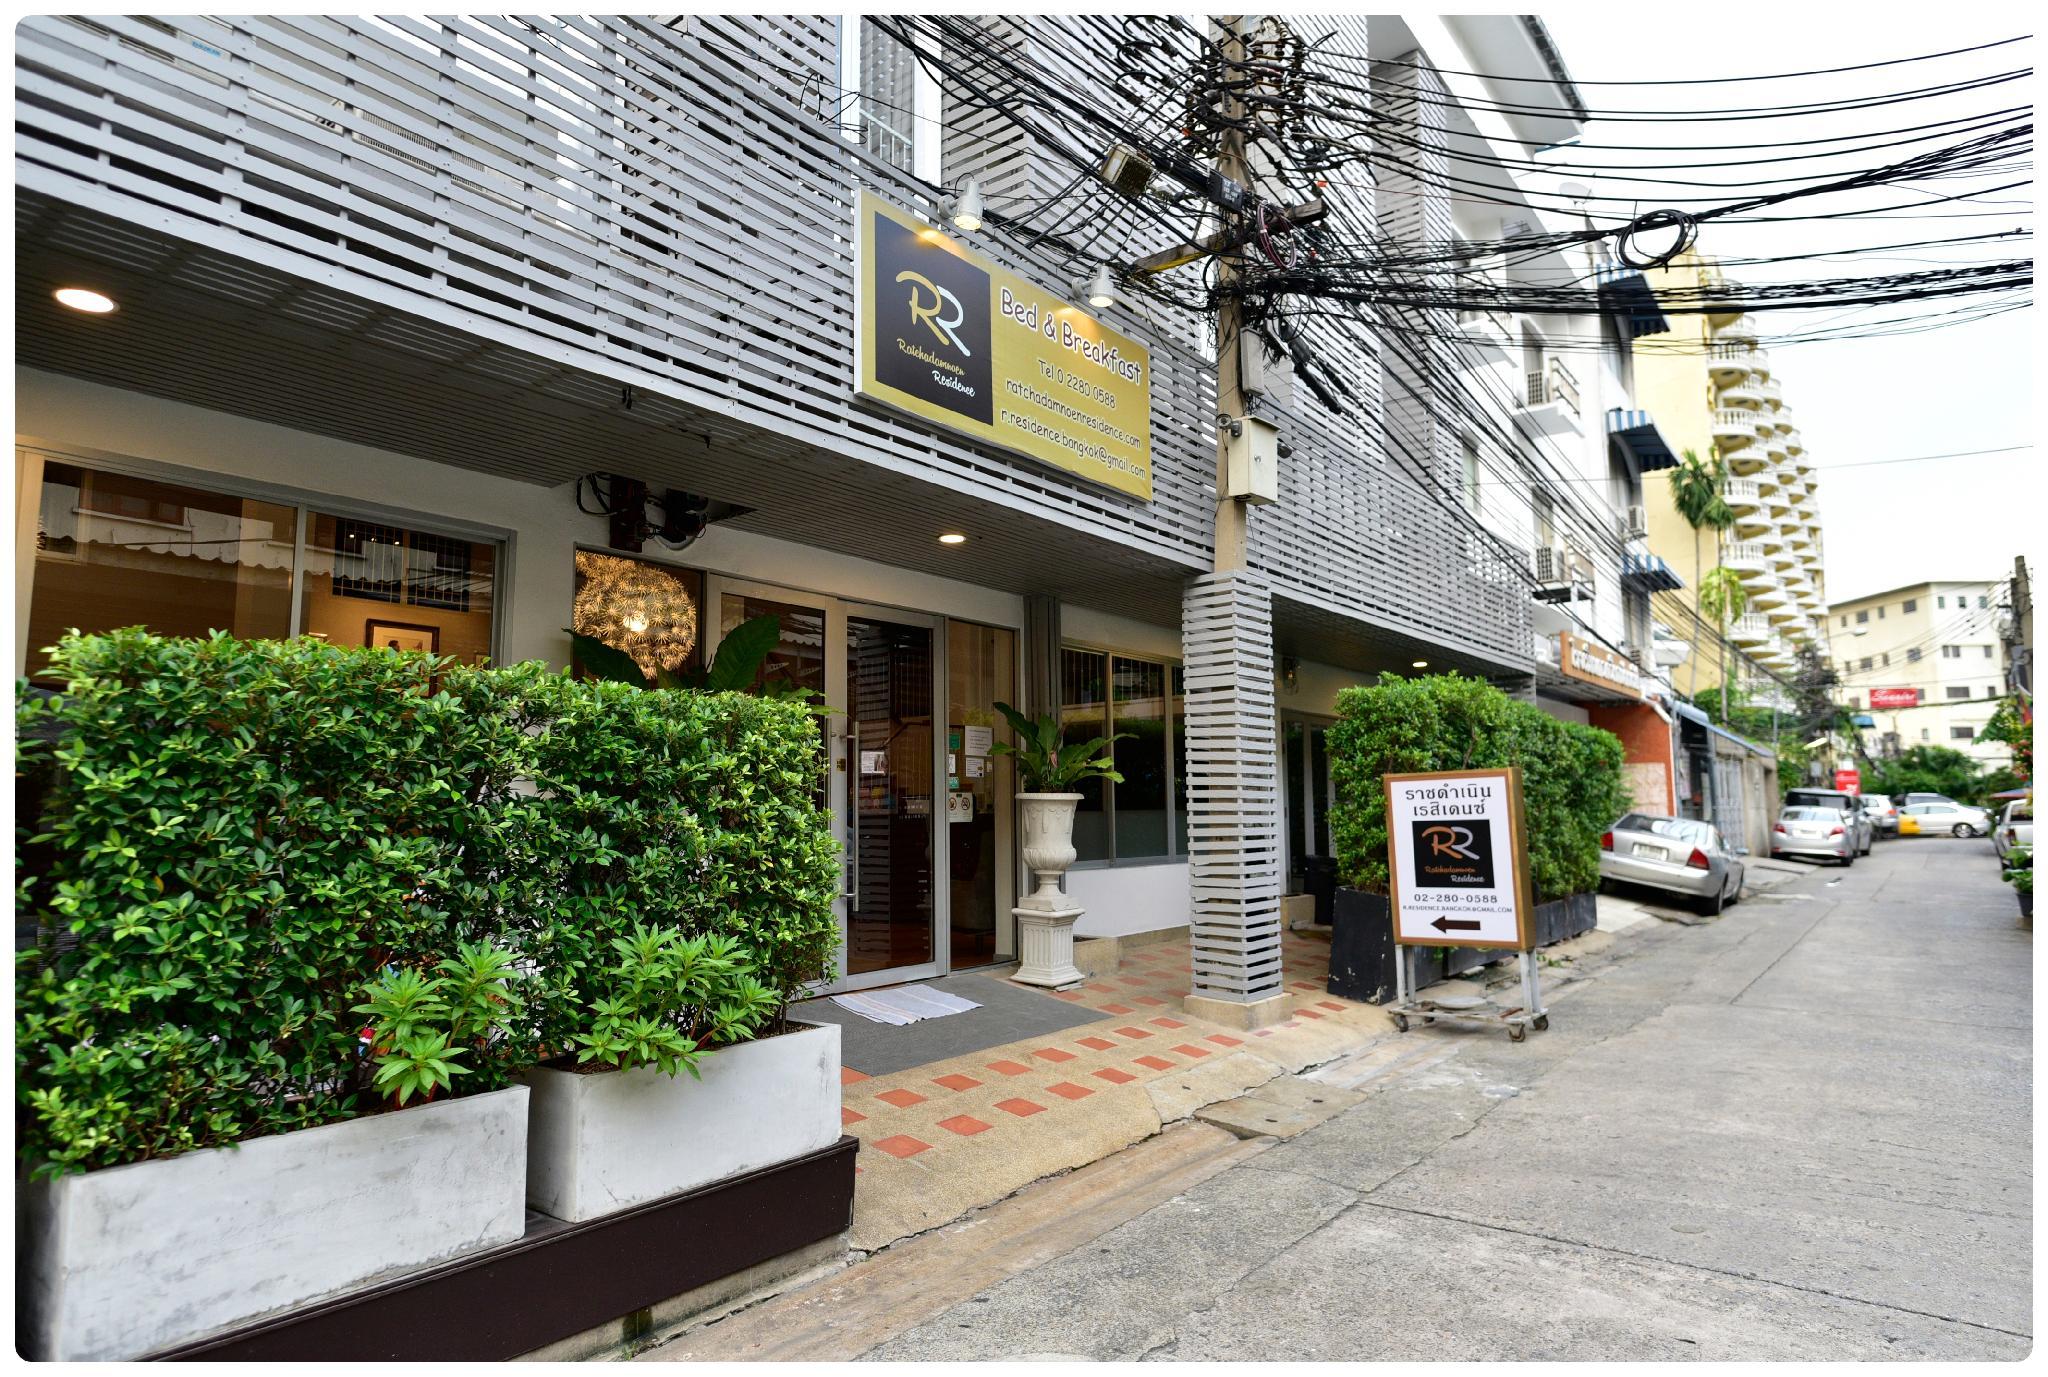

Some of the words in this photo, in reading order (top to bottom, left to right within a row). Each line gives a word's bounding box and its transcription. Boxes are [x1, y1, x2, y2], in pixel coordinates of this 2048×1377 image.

[1001, 288, 1038, 330] Bed
[1043, 313, 1057, 341] &
[1062, 321, 1142, 385] Breakfast
[896, 338, 966, 376] Ratchadamnoen
[931, 369, 976, 398] Residence
[1038, 359, 1054, 380] Tel
[1057, 369, 1064, 384] 0
[1067, 373, 1091, 397] 2280
[1093, 386, 1116, 409] 0588
[1006, 380, 1141, 448] ratchadamnoenresidence.com
[1001, 409, 1146, 479] r.residence.bangkok@gmail.com
[1405, 783, 1491, 800] ราชดำเนิน
[1450, 874, 1485, 882] Residence
[1414, 893, 1498, 903] 02-280-0588
